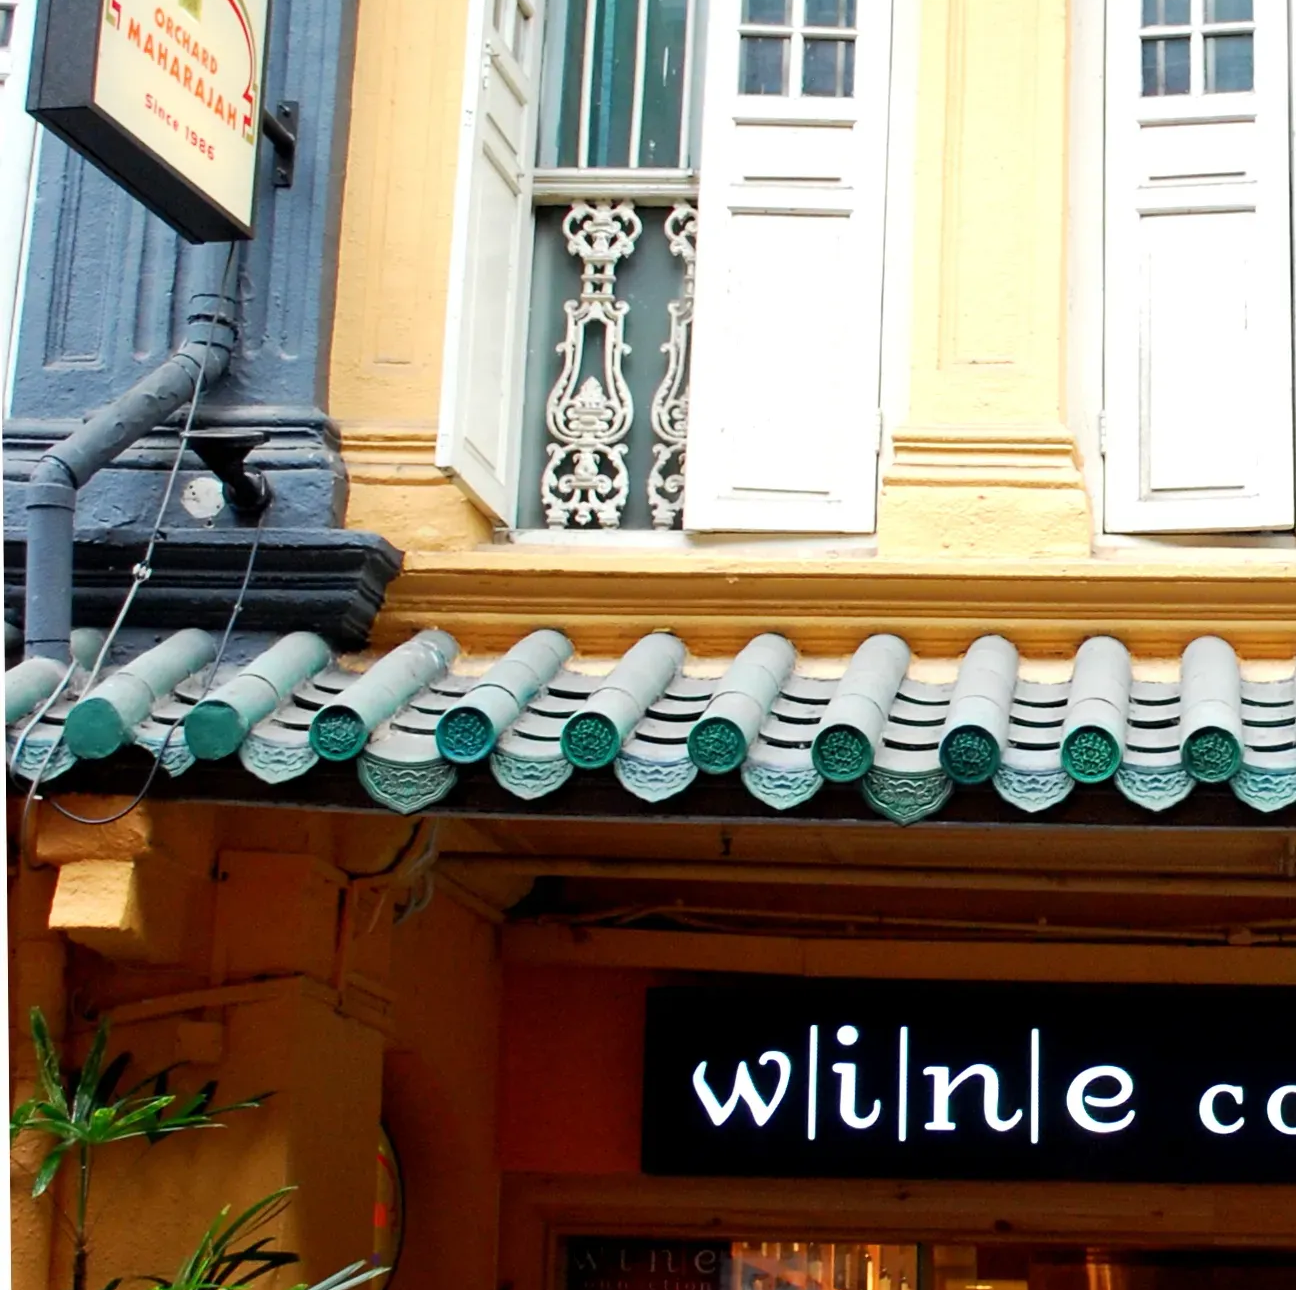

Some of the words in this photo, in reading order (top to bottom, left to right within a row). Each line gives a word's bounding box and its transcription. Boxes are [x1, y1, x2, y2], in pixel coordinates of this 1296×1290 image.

[127, 17, 238, 131] MAHARAJAH
[154, 7, 218, 75] ORCHARD
[144, 93, 180, 131] Since
[185, 125, 215, 161] 1986
